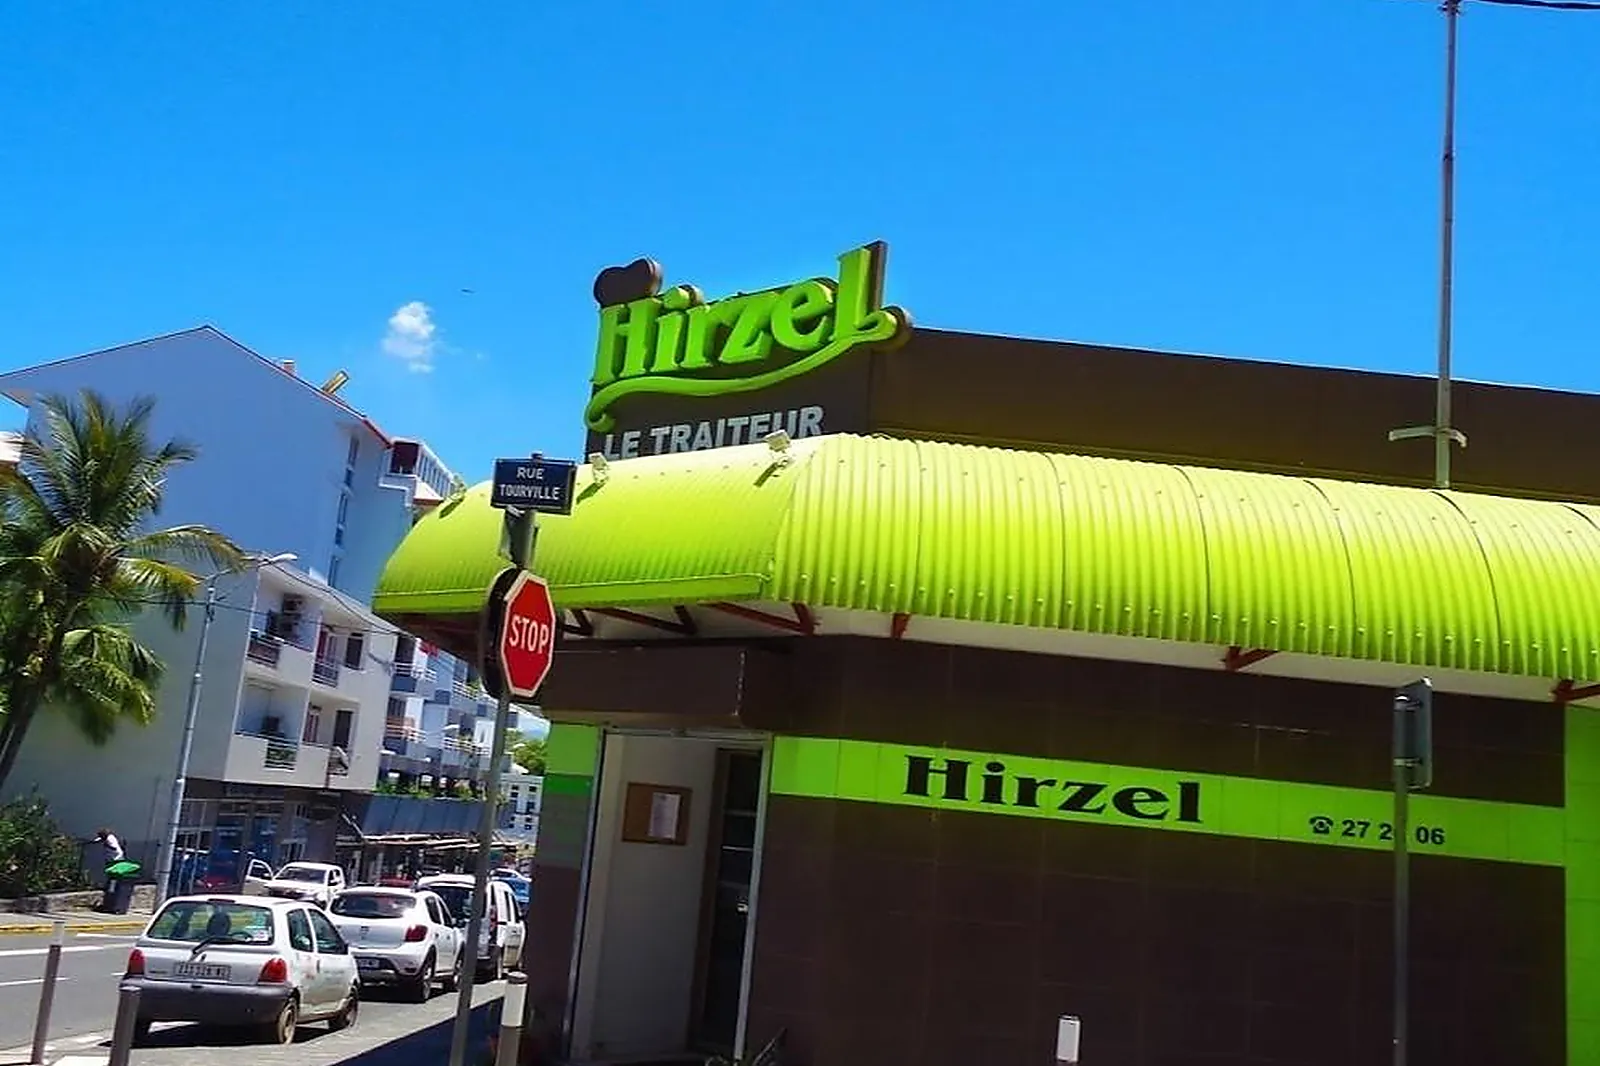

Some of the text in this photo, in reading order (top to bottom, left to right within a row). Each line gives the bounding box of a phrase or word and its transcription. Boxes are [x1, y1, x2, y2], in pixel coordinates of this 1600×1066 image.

[591, 244, 896, 386] Hirzel
[604, 406, 823, 460] LE TRAITEUR
[499, 484, 560, 500] TOURVILLE
[517, 466, 545, 480] RUE
[509, 616, 548, 654] STOP
[903, 755, 1202, 822] Hirzel
[1343, 820, 1371, 838] 27
[1416, 826, 1445, 845] 06
